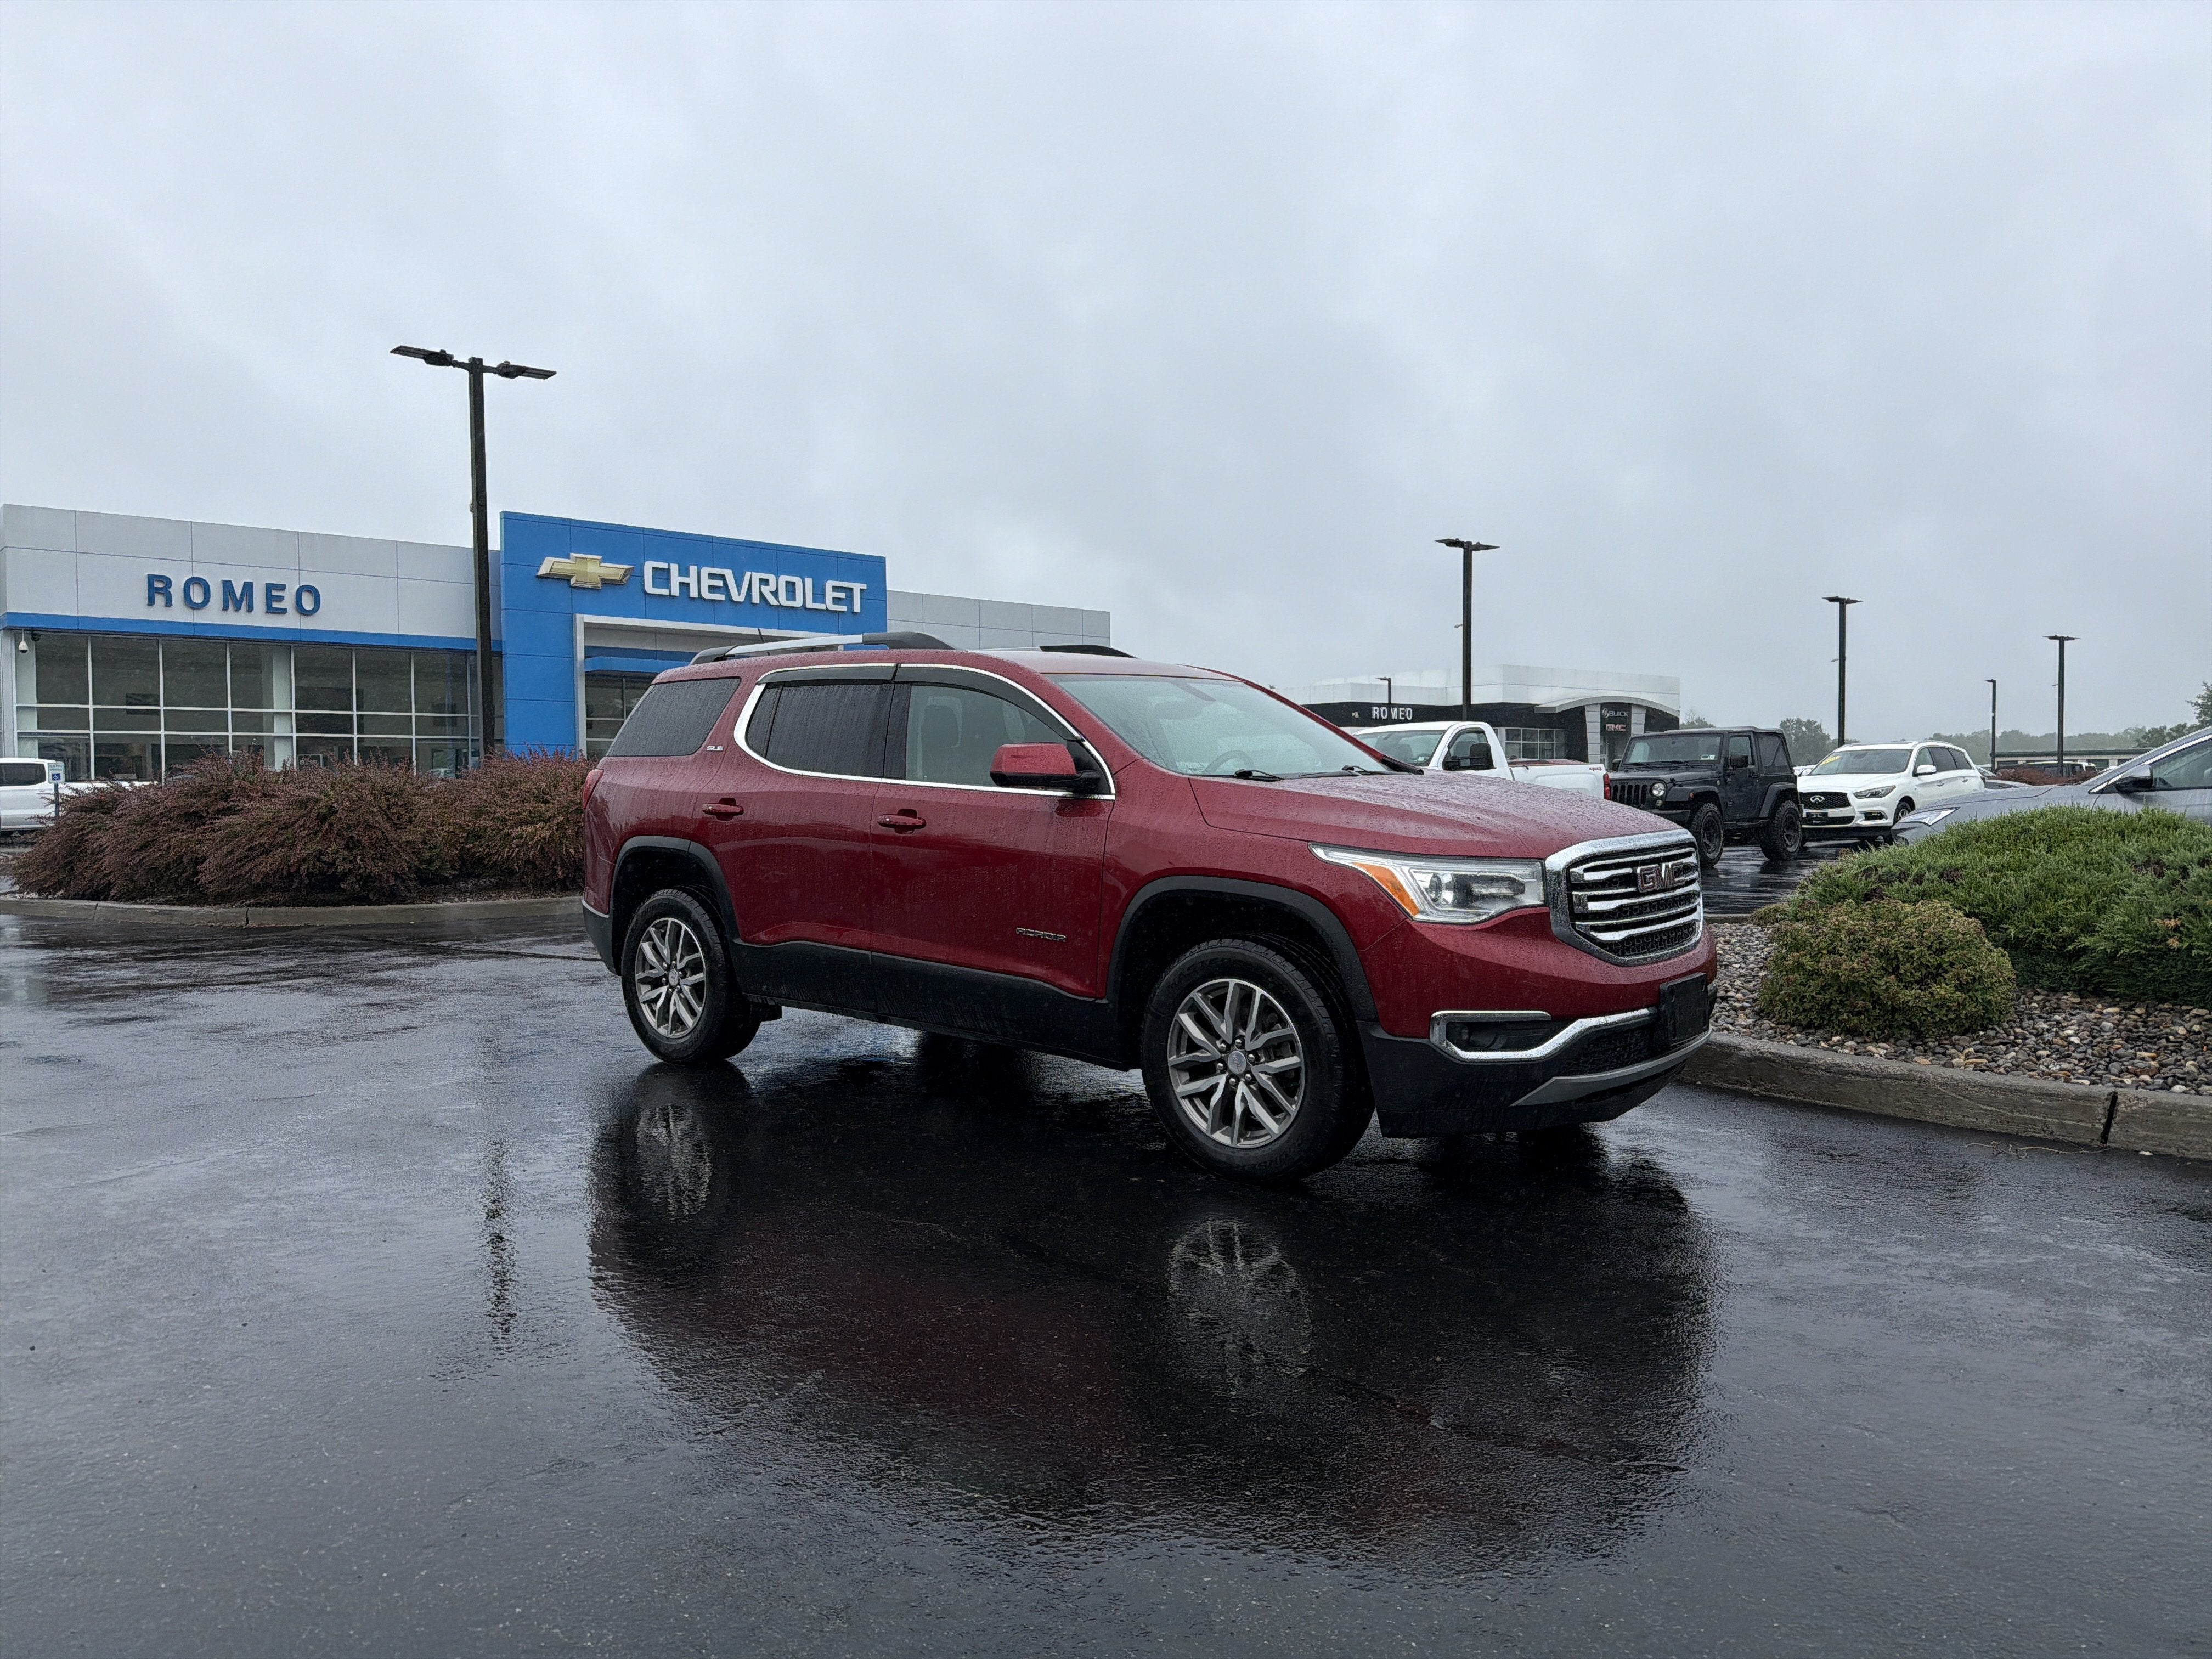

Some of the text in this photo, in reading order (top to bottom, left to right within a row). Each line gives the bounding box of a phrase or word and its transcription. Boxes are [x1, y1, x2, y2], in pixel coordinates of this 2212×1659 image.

[147, 574, 320, 616] ROMEO
[644, 561, 867, 613] CHEVROLET
[1372, 706, 1413, 720] ROMEO
[1637, 861, 1686, 893] GMC
[1016, 927, 1066, 942] ACADIA
